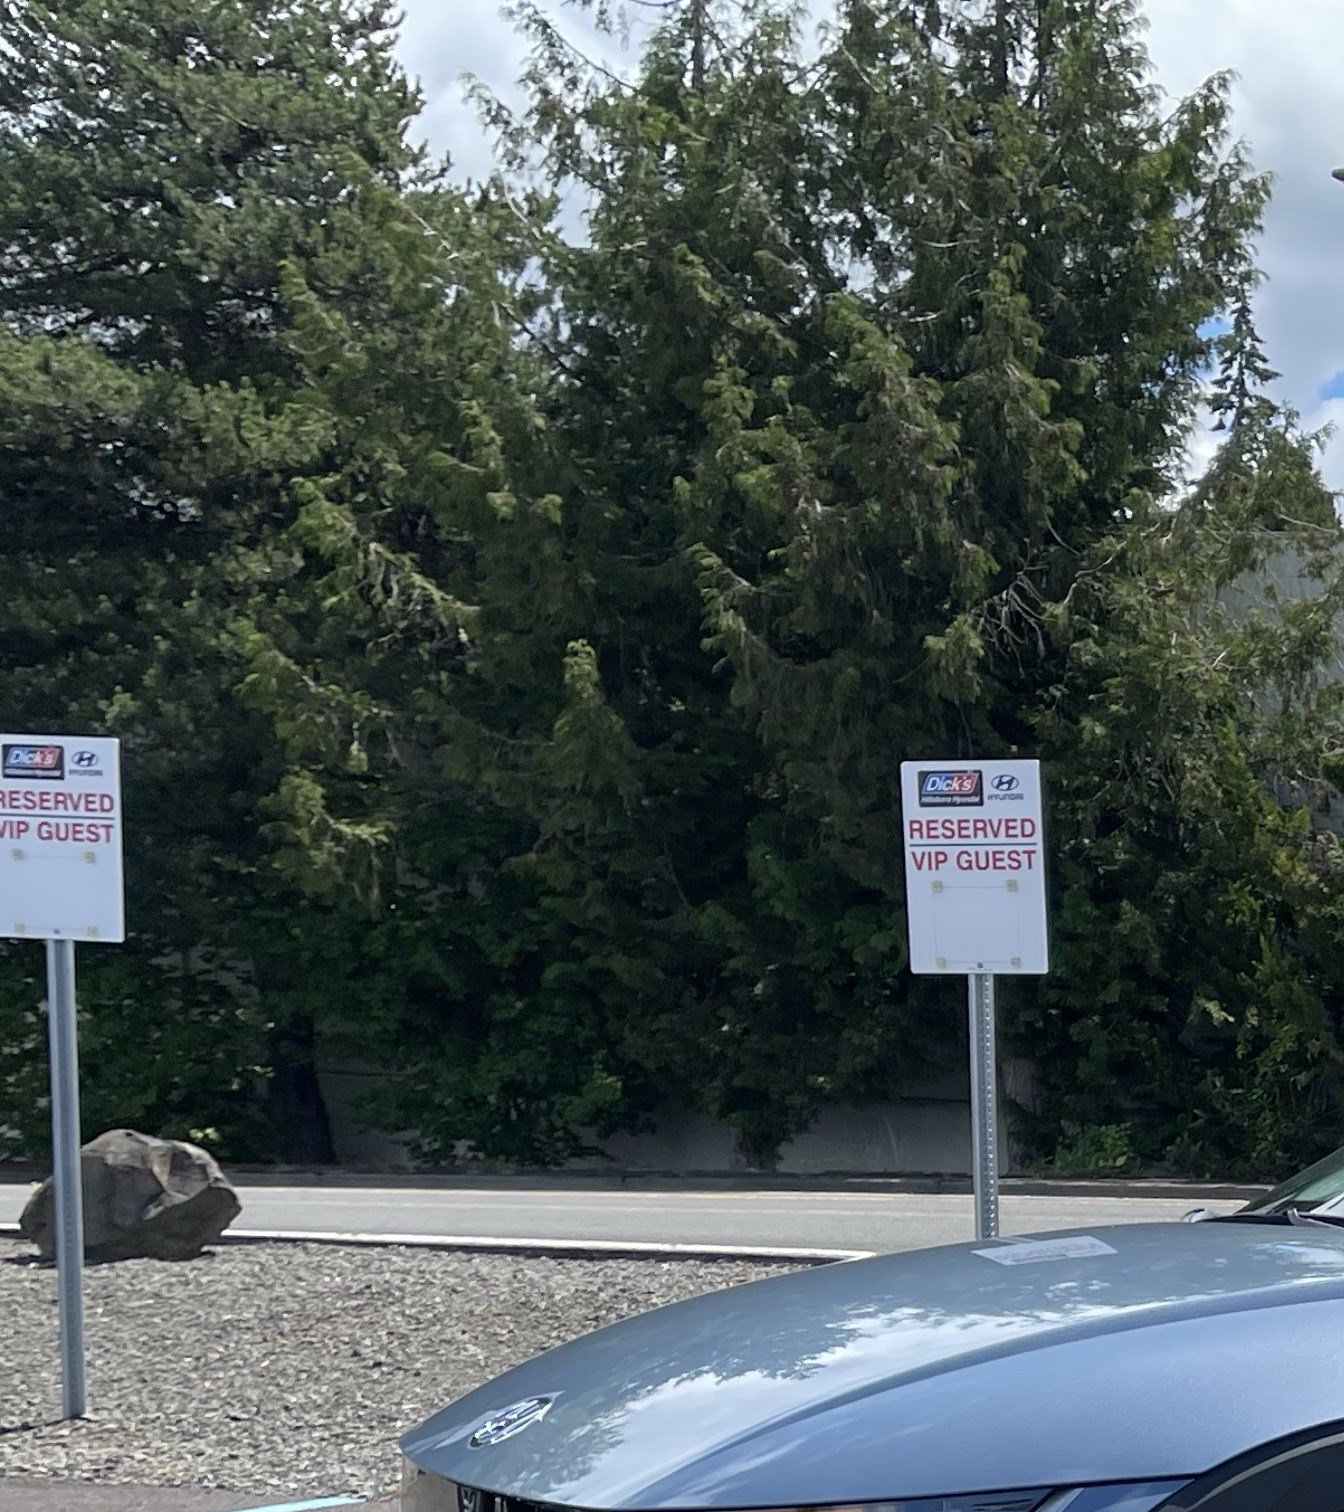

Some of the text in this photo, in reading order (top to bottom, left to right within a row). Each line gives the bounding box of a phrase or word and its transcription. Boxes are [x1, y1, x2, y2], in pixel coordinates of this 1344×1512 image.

[37, 821, 114, 843] GUEST
[909, 818, 1036, 839] RESERVED
[911, 850, 1036, 871] VIP GUEST
